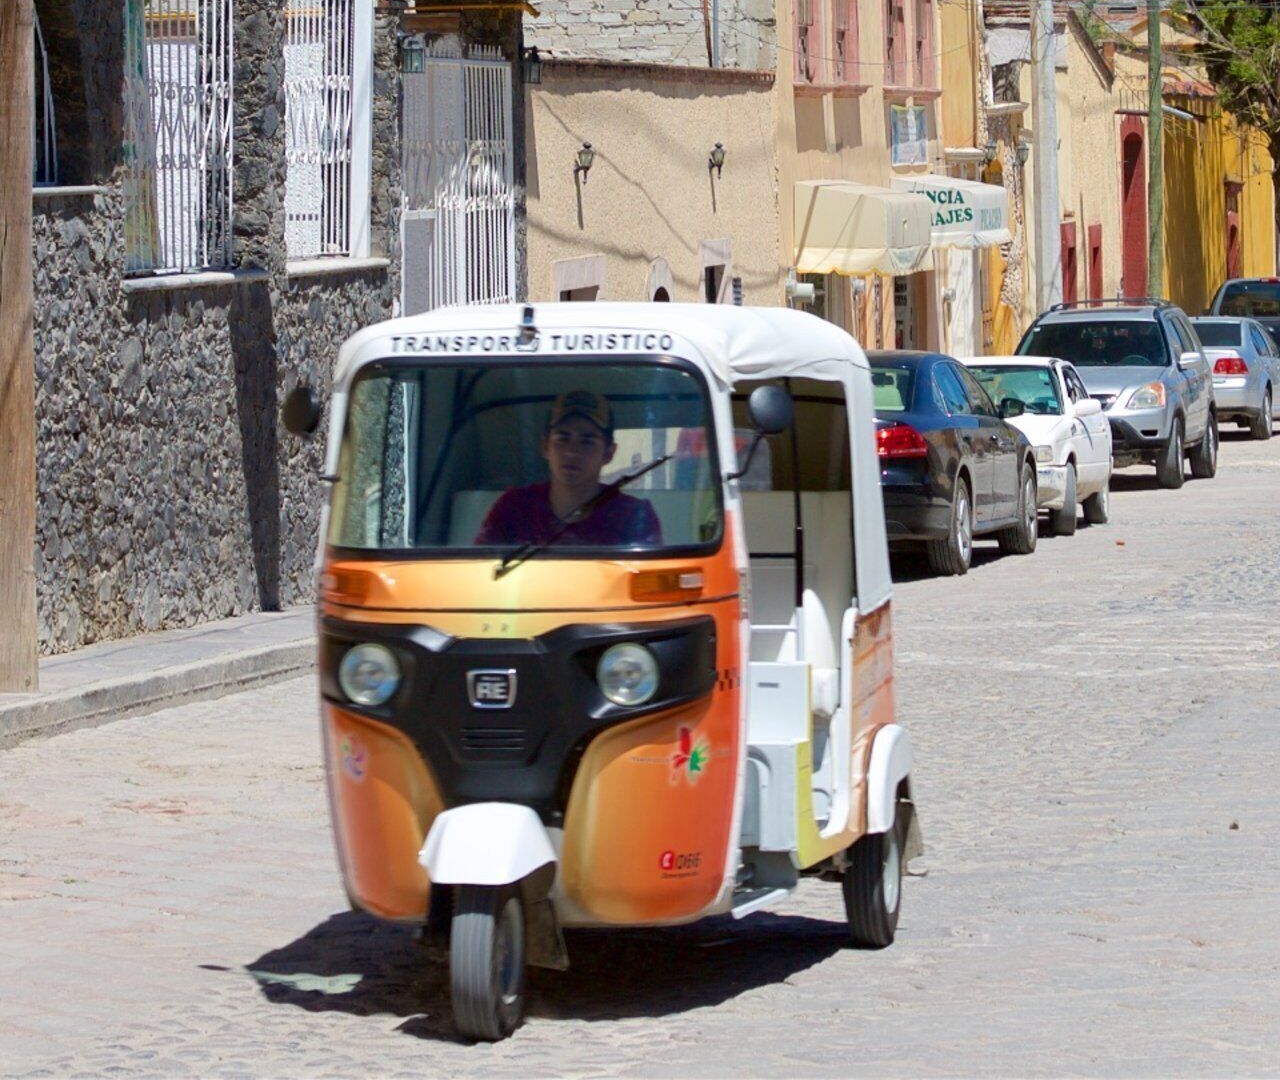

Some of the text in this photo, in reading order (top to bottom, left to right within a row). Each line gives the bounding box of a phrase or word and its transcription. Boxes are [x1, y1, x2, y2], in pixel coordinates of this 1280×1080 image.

[390, 333, 674, 353] TRANSPOR TURISTICO
[476, 682, 508, 699] RE
